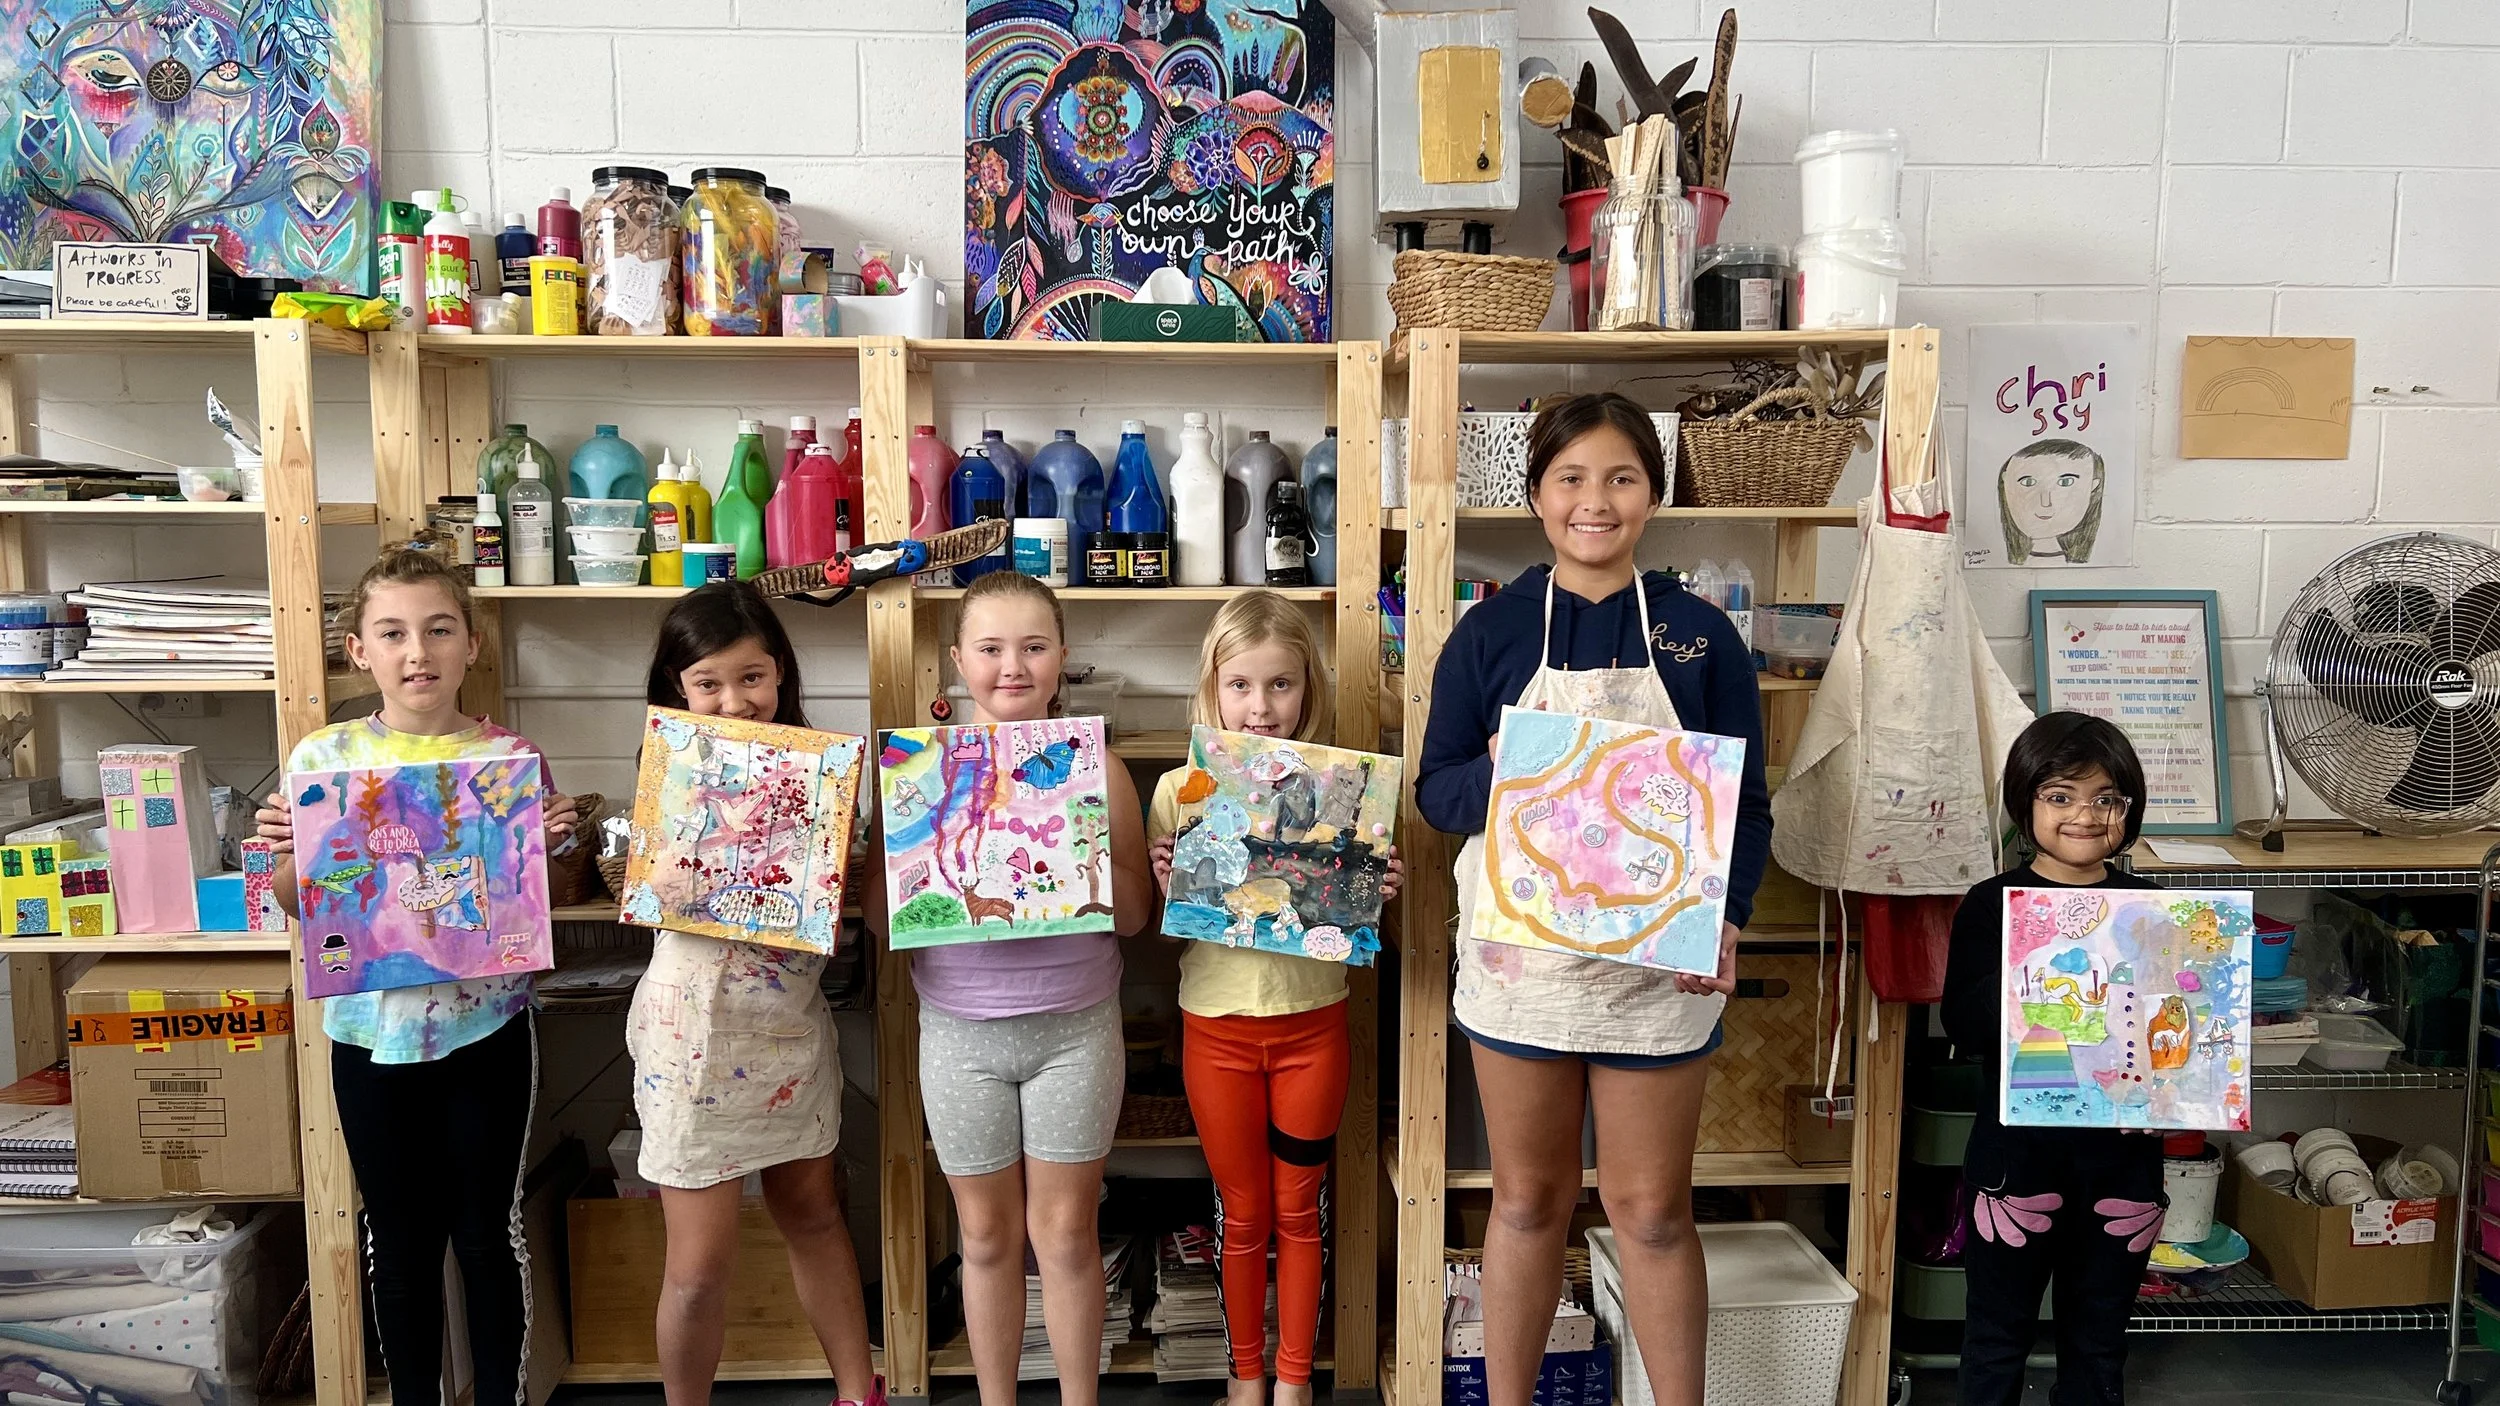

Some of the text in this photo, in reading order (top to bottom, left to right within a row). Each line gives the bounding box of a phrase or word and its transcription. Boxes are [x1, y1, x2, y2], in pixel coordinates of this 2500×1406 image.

[1126, 194, 1217, 232] choose
[67, 249, 173, 269] Artworks in
[1122, 230, 1302, 277] own path
[441, 264, 460, 273] GLUE
[65, 296, 95, 306] Please
[99, 297, 113, 307] be
[1996, 362, 2107, 415] chri
[2031, 401, 2092, 436] ssy
[2093, 622, 2191, 632] How to talk to kids about
[1649, 622, 1706, 663] hey
[2141, 634, 2186, 644] ART MAKING
[2136, 666, 2146, 675] ME
[2147, 666, 2168, 675] ABOUT
[2436, 669, 2467, 682] Rok
[2095, 691, 2110, 701] GOT
[2124, 693, 2146, 701] NOTICE
[2147, 693, 2171, 701] YOU'RE
[2172, 693, 2197, 701] REALLY
[2093, 707, 2113, 717] GOOD
[2120, 706, 2145, 715] TAKING
[2146, 706, 2163, 715] YOUR
[2170, 784, 2179, 793] TO
[1520, 799, 1553, 829] yolo!
[390, 825, 409, 840] AND
[384, 839, 394, 850] TO
[899, 861, 927, 895] yolo!
[129, 1010, 267, 1040] FRAGILE
